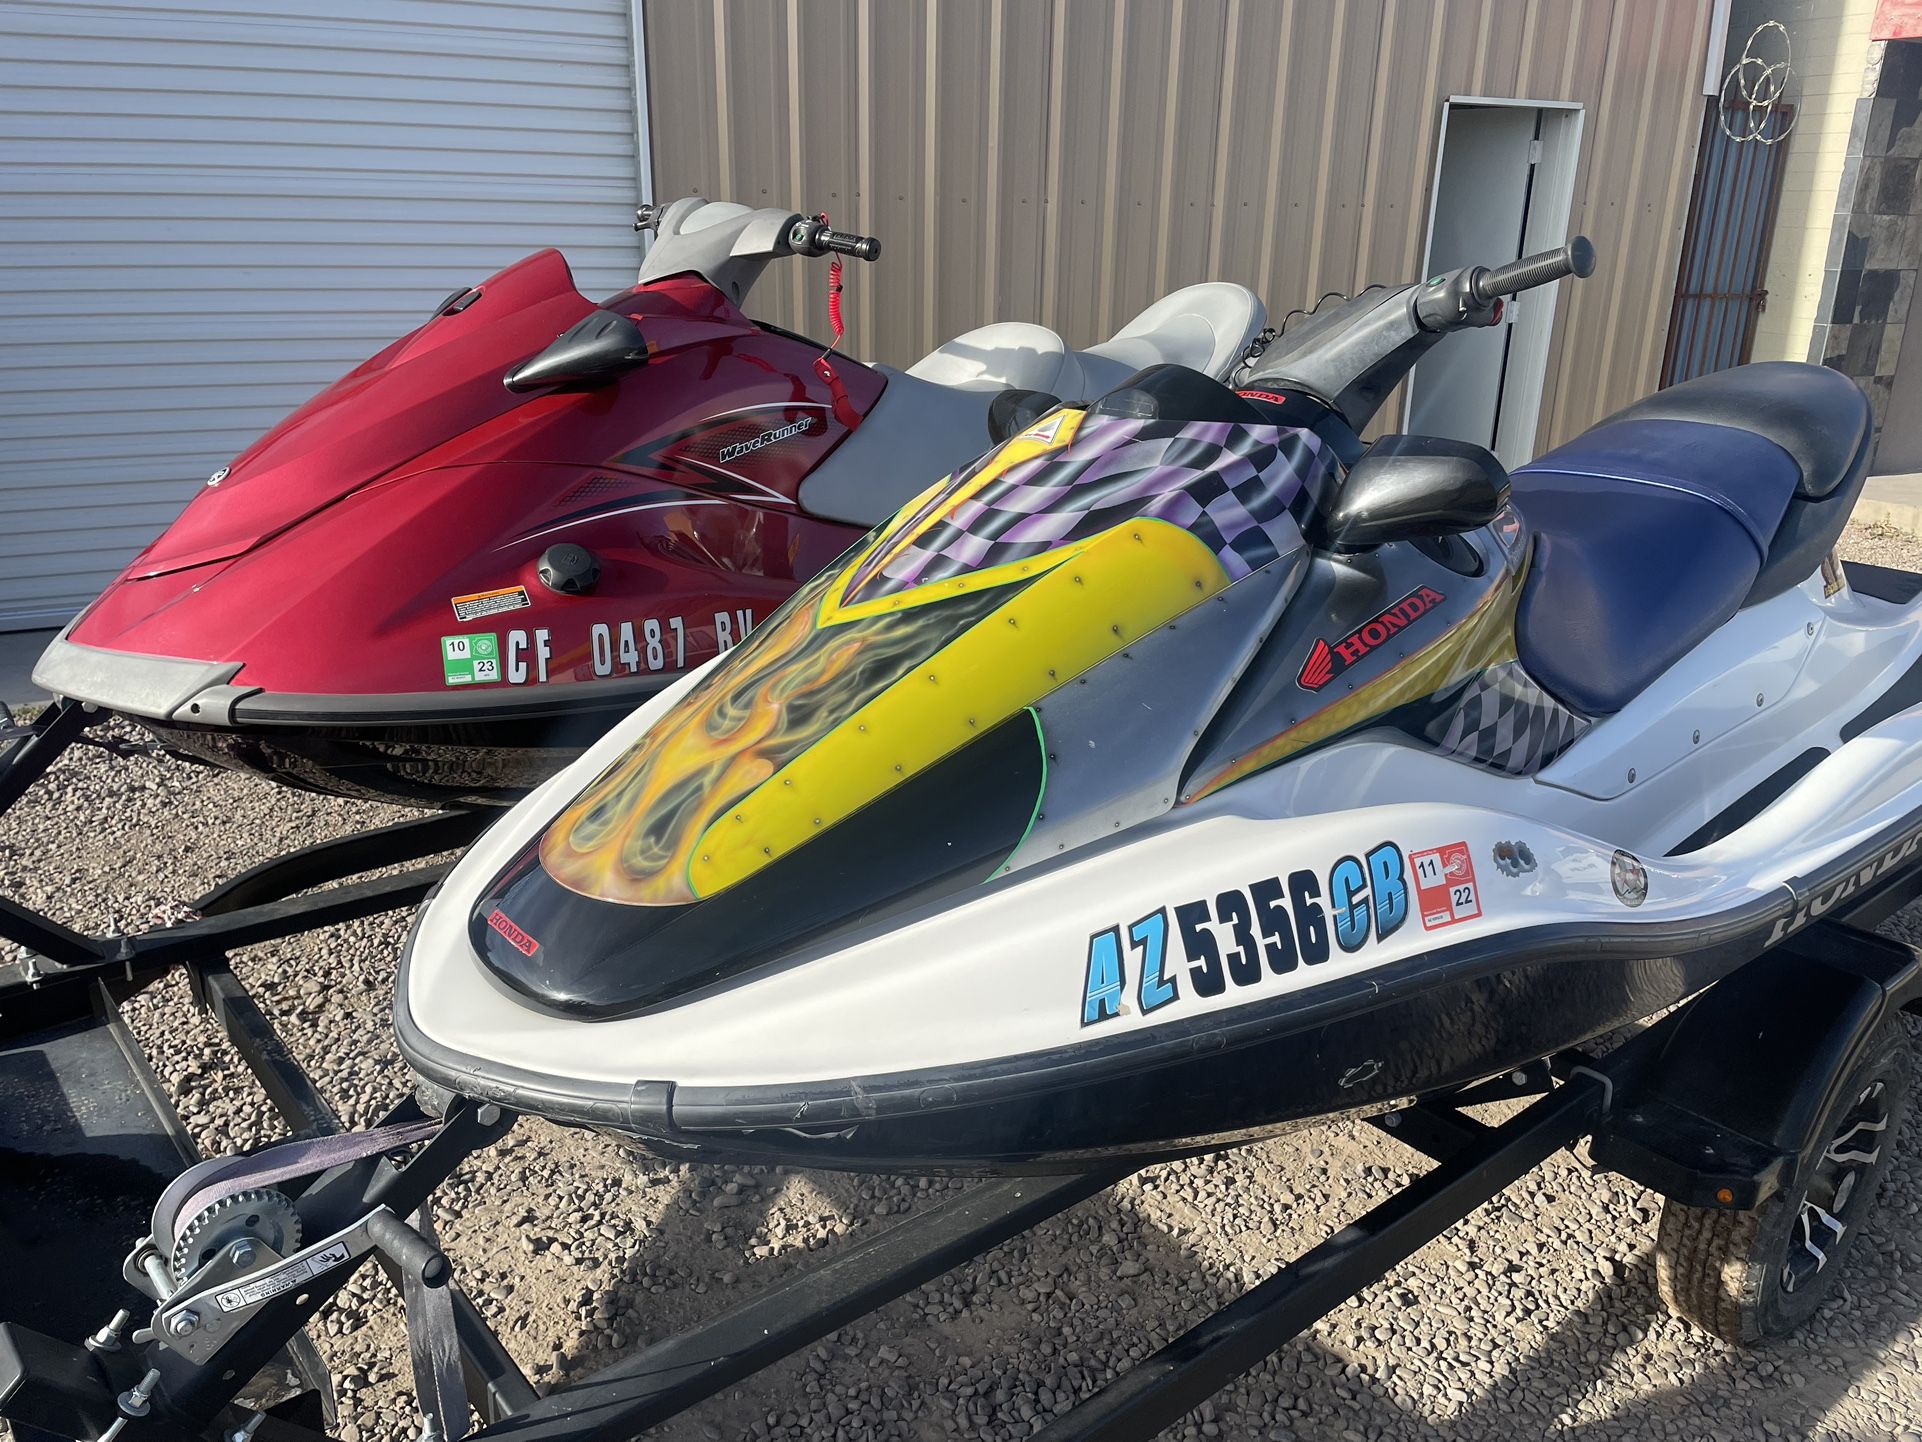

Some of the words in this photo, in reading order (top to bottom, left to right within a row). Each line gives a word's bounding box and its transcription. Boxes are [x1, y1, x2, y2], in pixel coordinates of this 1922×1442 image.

[1238, 391, 1280, 402] ONDA
[720, 416, 812, 463] WaveRunner
[1334, 587, 1446, 666] HONDA
[448, 640, 466, 653] 10
[507, 628, 551, 685] CF
[590, 616, 685, 677] 0487
[477, 660, 495, 673] 23
[1418, 858, 1437, 879] 11
[1453, 886, 1473, 907] 22
[489, 912, 533, 954] HONDA
